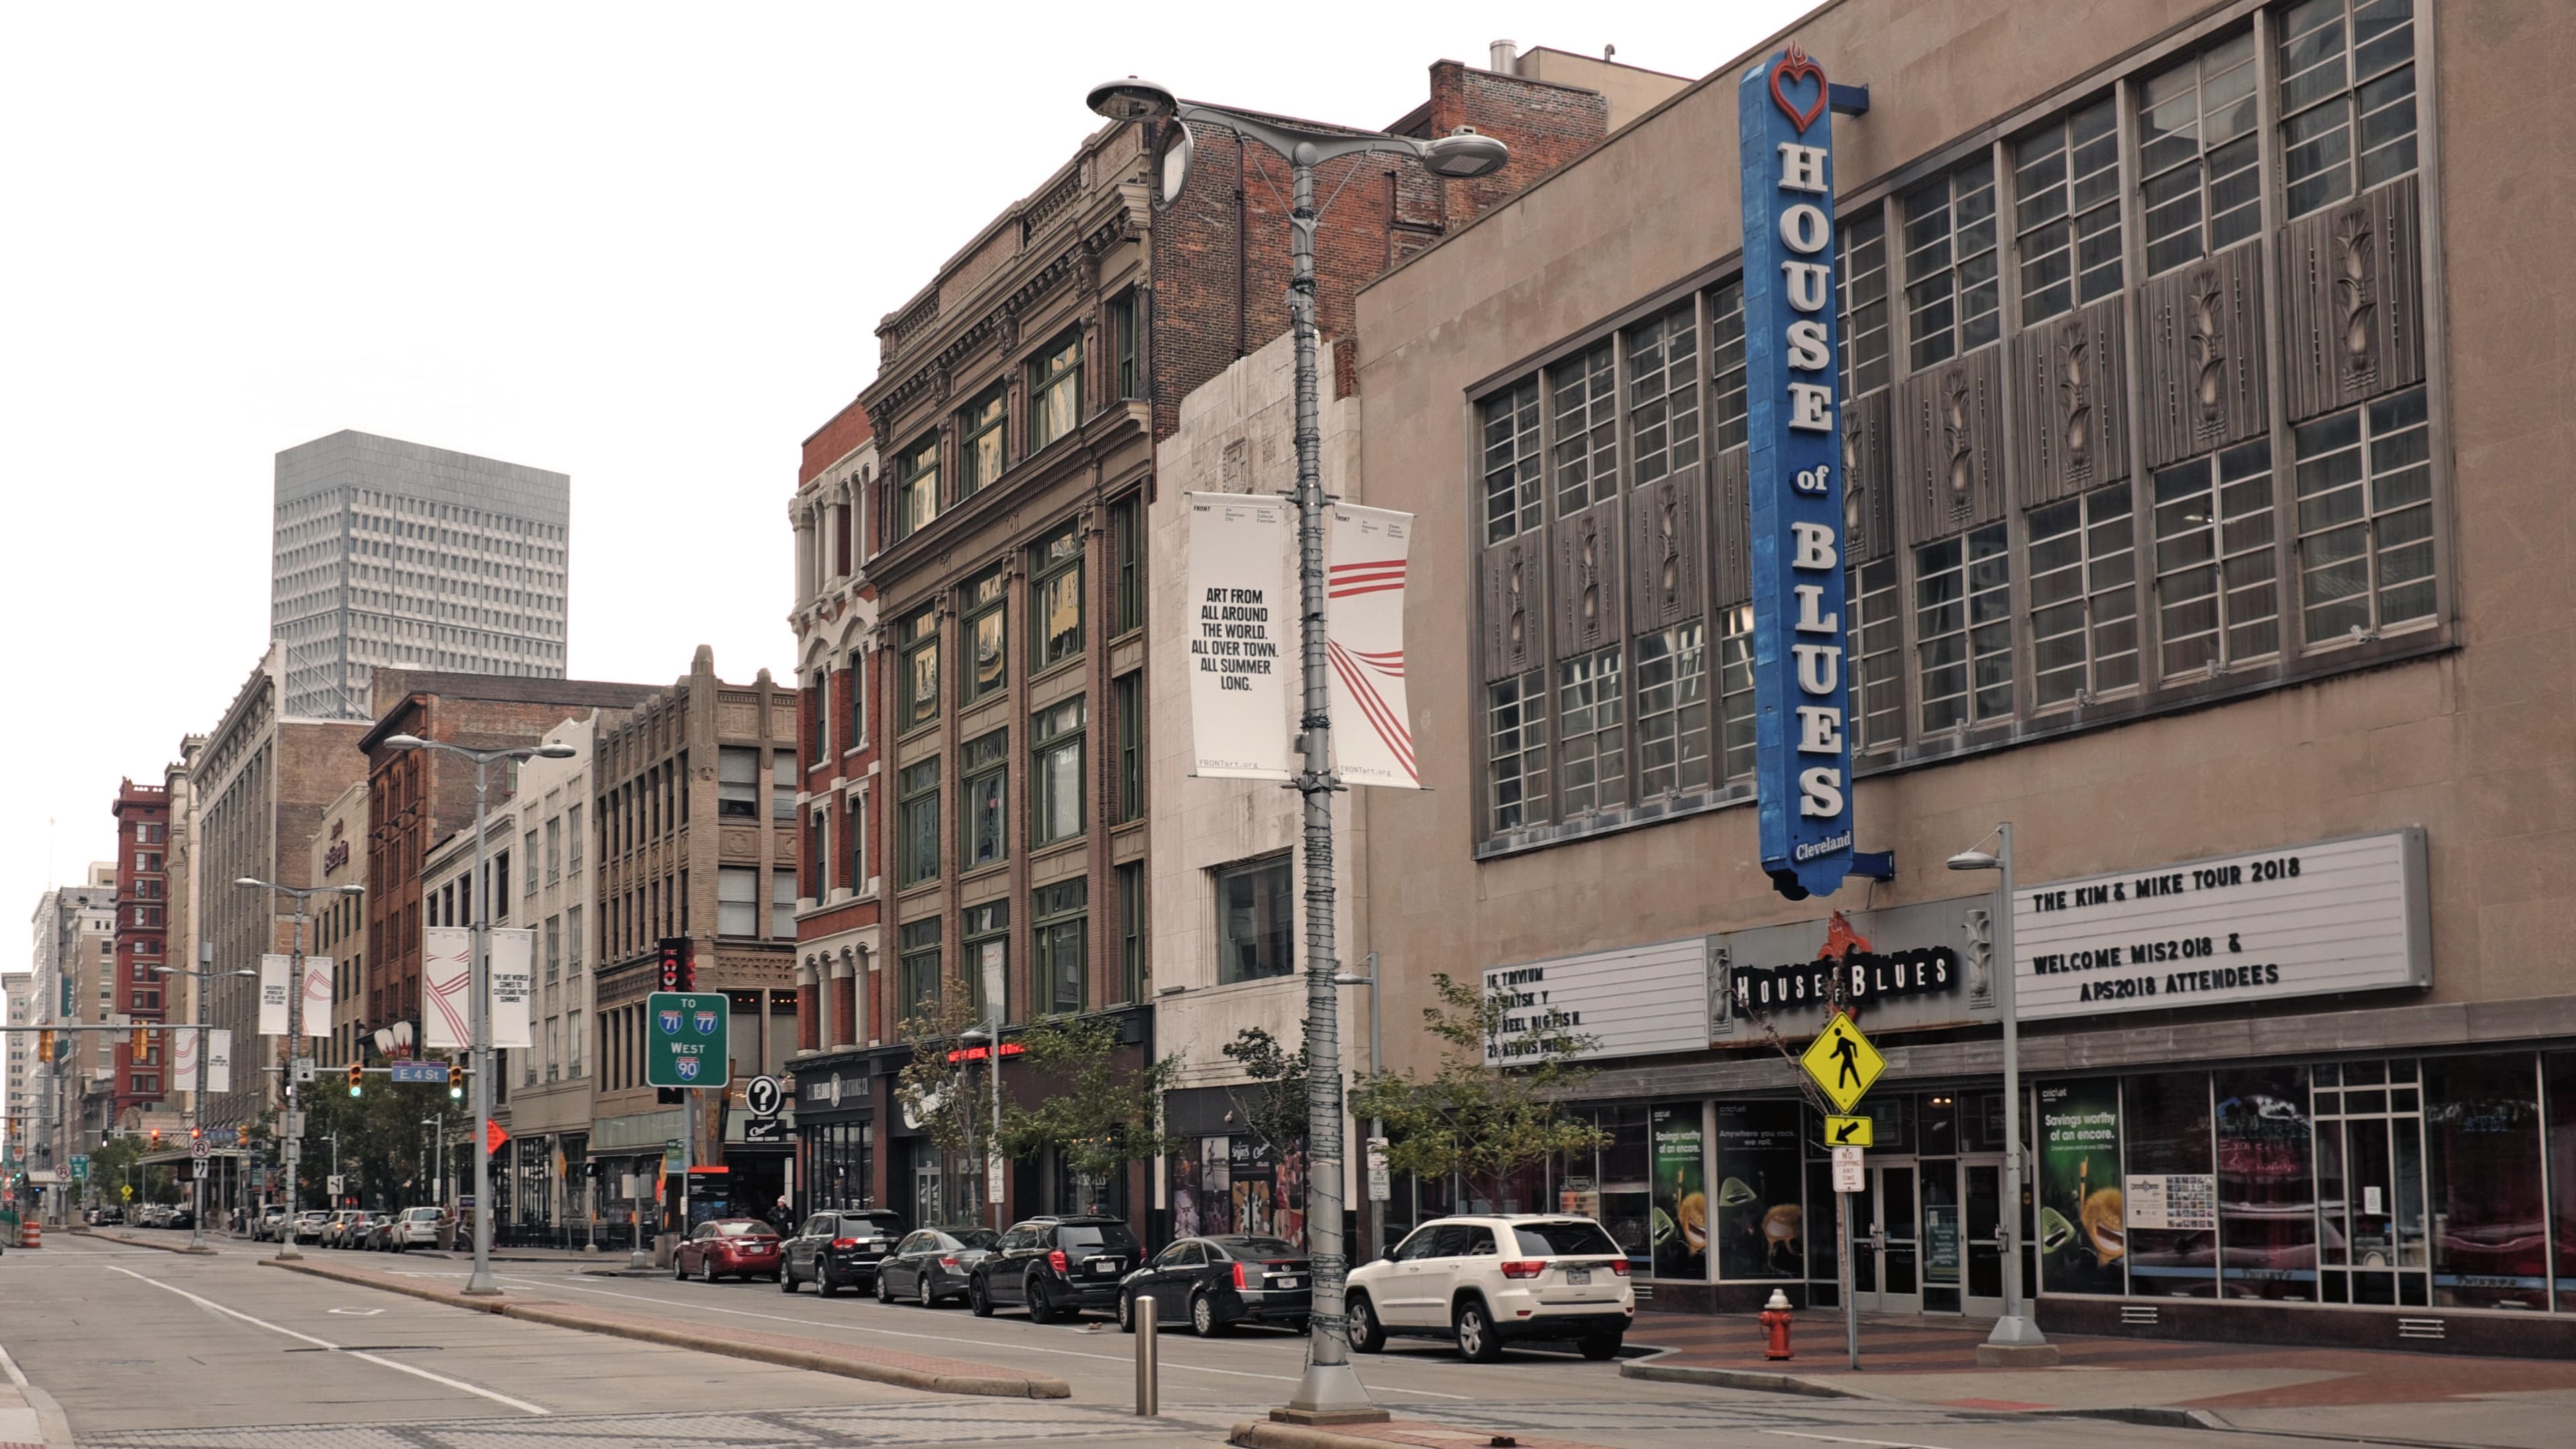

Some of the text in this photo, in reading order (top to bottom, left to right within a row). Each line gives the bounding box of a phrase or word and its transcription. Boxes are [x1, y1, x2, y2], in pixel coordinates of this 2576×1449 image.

[1777, 142, 1843, 817] HOUSE of BLUES
[1206, 588, 1263, 604] ART FROM
[1201, 605, 1267, 622] ALL AROUND
[1201, 623, 1268, 640] THE WORLD.
[1191, 640, 1279, 657] ALL OVER TOWN.
[1201, 657, 1271, 674] ALL SUMMER
[1221, 676, 1252, 691] LONG.
[1199, 759, 1259, 769] FRONTart.org
[1796, 830, 1851, 860] Cleveland
[2033, 857, 2301, 912] THE KIM & MIKE TOUR 2018
[2033, 948, 2121, 975] WELCOME
[2228, 933, 2242, 953] &
[1501, 967, 1544, 986] TRIVIUM
[1737, 973, 1823, 1007] HOUSE
[1851, 958, 1946, 997] BLUES
[2080, 964, 2279, 1002] APS2018 ATTENDEES
[680, 999, 696, 1008] TO
[663, 1017, 714, 1031] 71 77
[671, 1042, 705, 1054] WEST
[399, 1069, 439, 1079] E. 4 St
[678, 1063, 697, 1076] 90
[2045, 1112, 2116, 1128] Savings worthy
[1655, 1132, 1680, 1142] Savings
[1719, 1130, 1759, 1138] Anywhere
[2050, 1129, 2114, 1140] of an encore.
[1659, 1144, 1666, 1153] of
[1676, 1144, 1701, 1153] encore.
